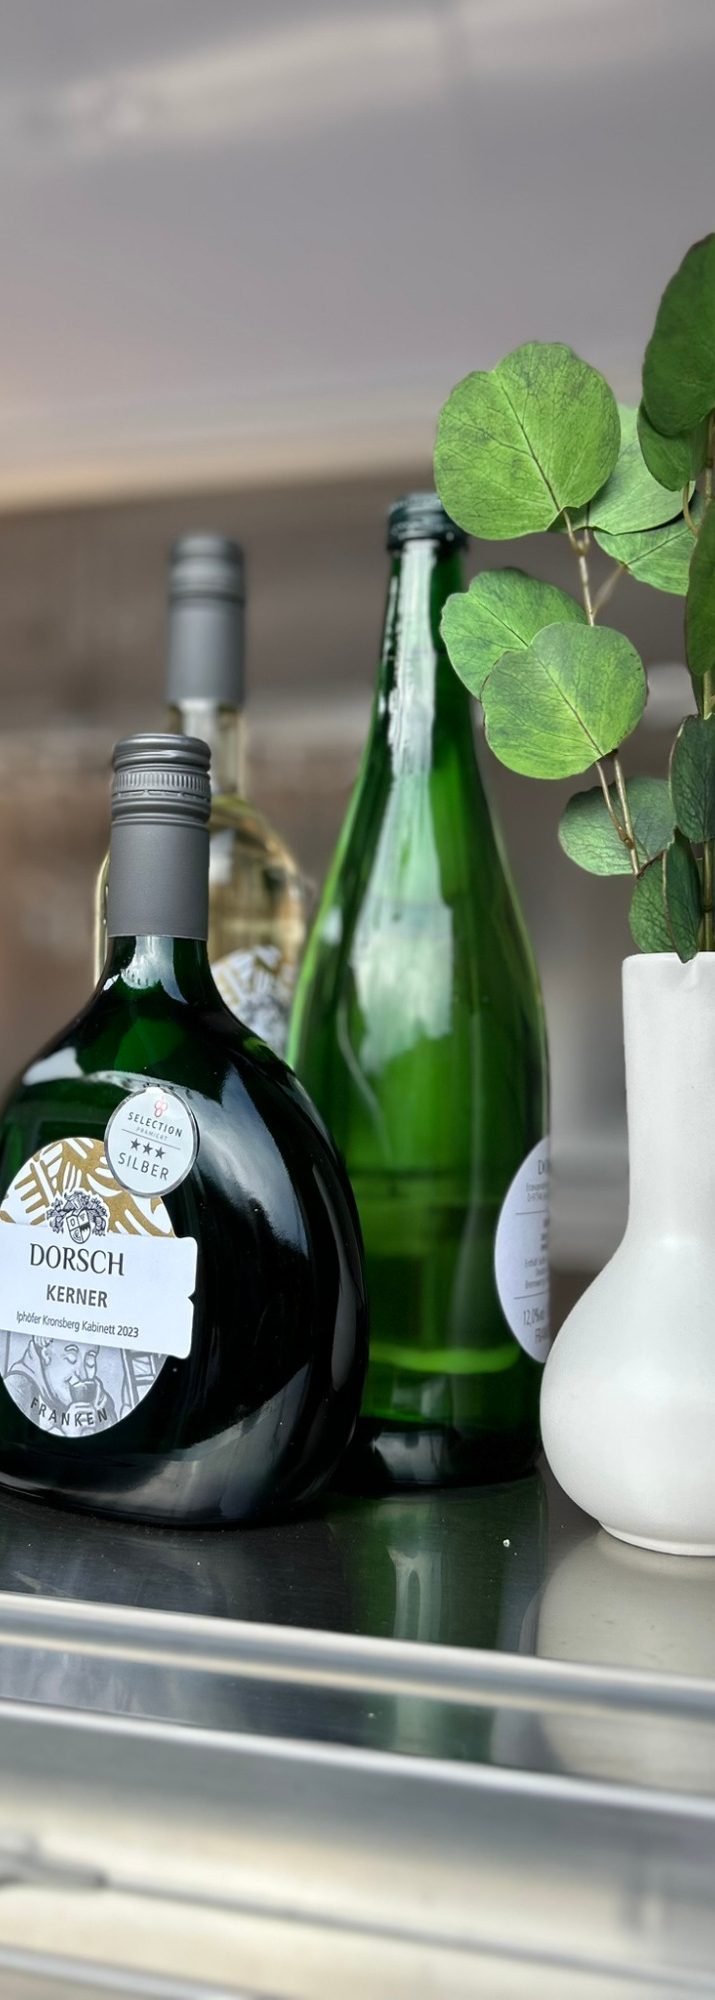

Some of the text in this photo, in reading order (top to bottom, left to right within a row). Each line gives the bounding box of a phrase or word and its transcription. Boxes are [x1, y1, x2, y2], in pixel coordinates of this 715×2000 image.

[128, 1111, 183, 1138] SELECTION
[118, 1152, 169, 1181] SILBER
[30, 1243, 124, 1276] DORSCH
[46, 1284, 108, 1308] KERNER
[16, 1311, 140, 1338] Iphöfer Kronsberg Kabinett 2023
[30, 1396, 108, 1427] FRANKEN
